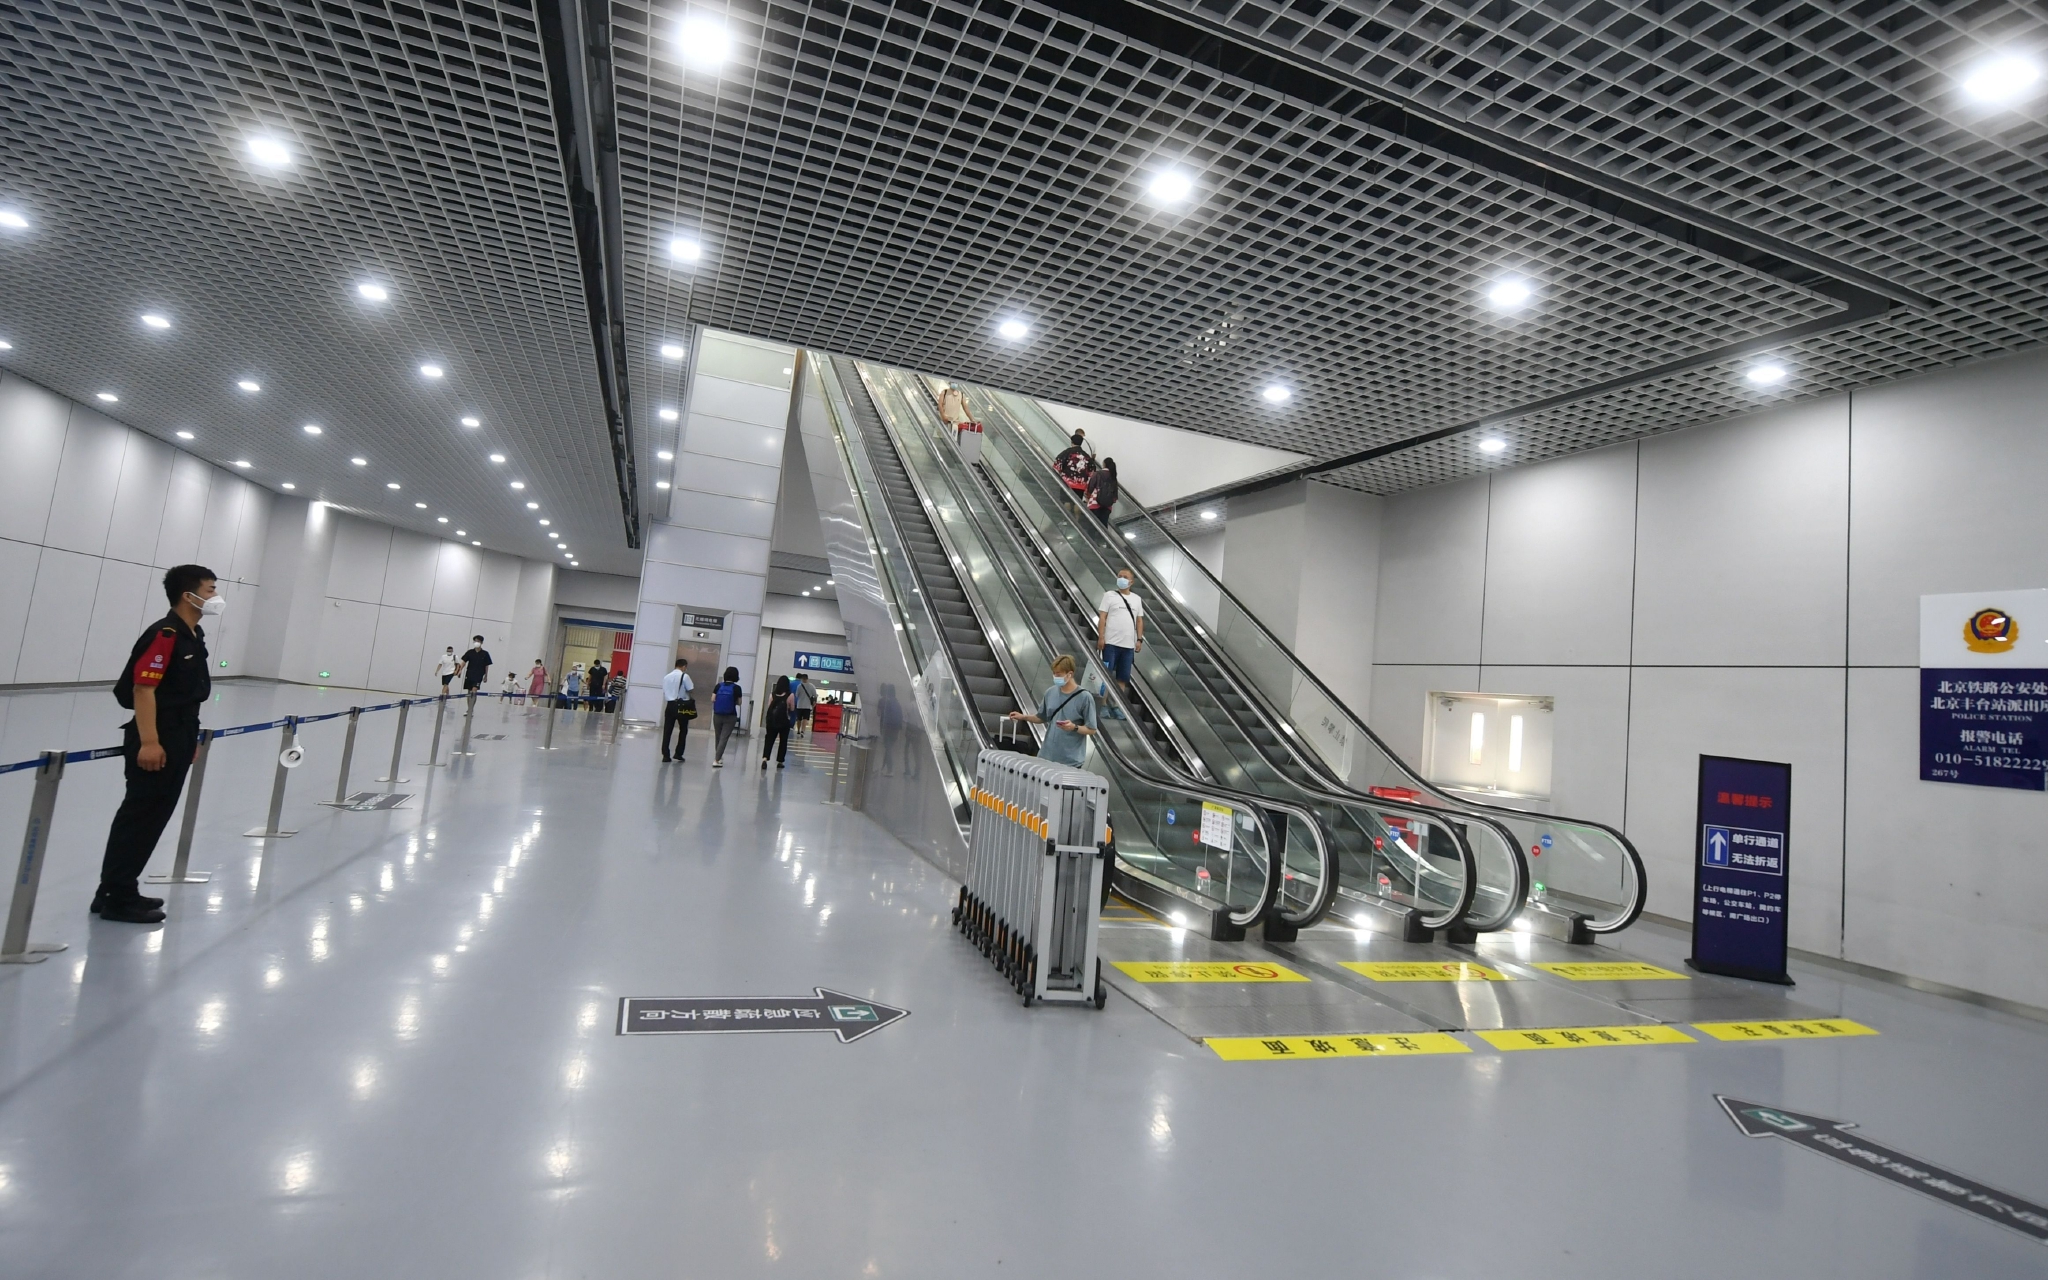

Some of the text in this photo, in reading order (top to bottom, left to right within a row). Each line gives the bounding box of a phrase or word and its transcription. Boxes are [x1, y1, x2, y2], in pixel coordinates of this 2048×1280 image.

[1938, 681, 2048, 695] 北京铁路公安处
[1951, 713, 2032, 722] POLICE STATION
[1960, 729, 2023, 745] 报警电话
[1963, 745, 1996, 753] ALARM
[1717, 791, 1773, 809] 温馨提示
[1732, 833, 1779, 849] 单行通道
[1732, 853, 1779, 869] 无法折返
[639, 1007, 821, 1021] 应急疏散方向
[1261, 1036, 1420, 1055] 注意坡面
